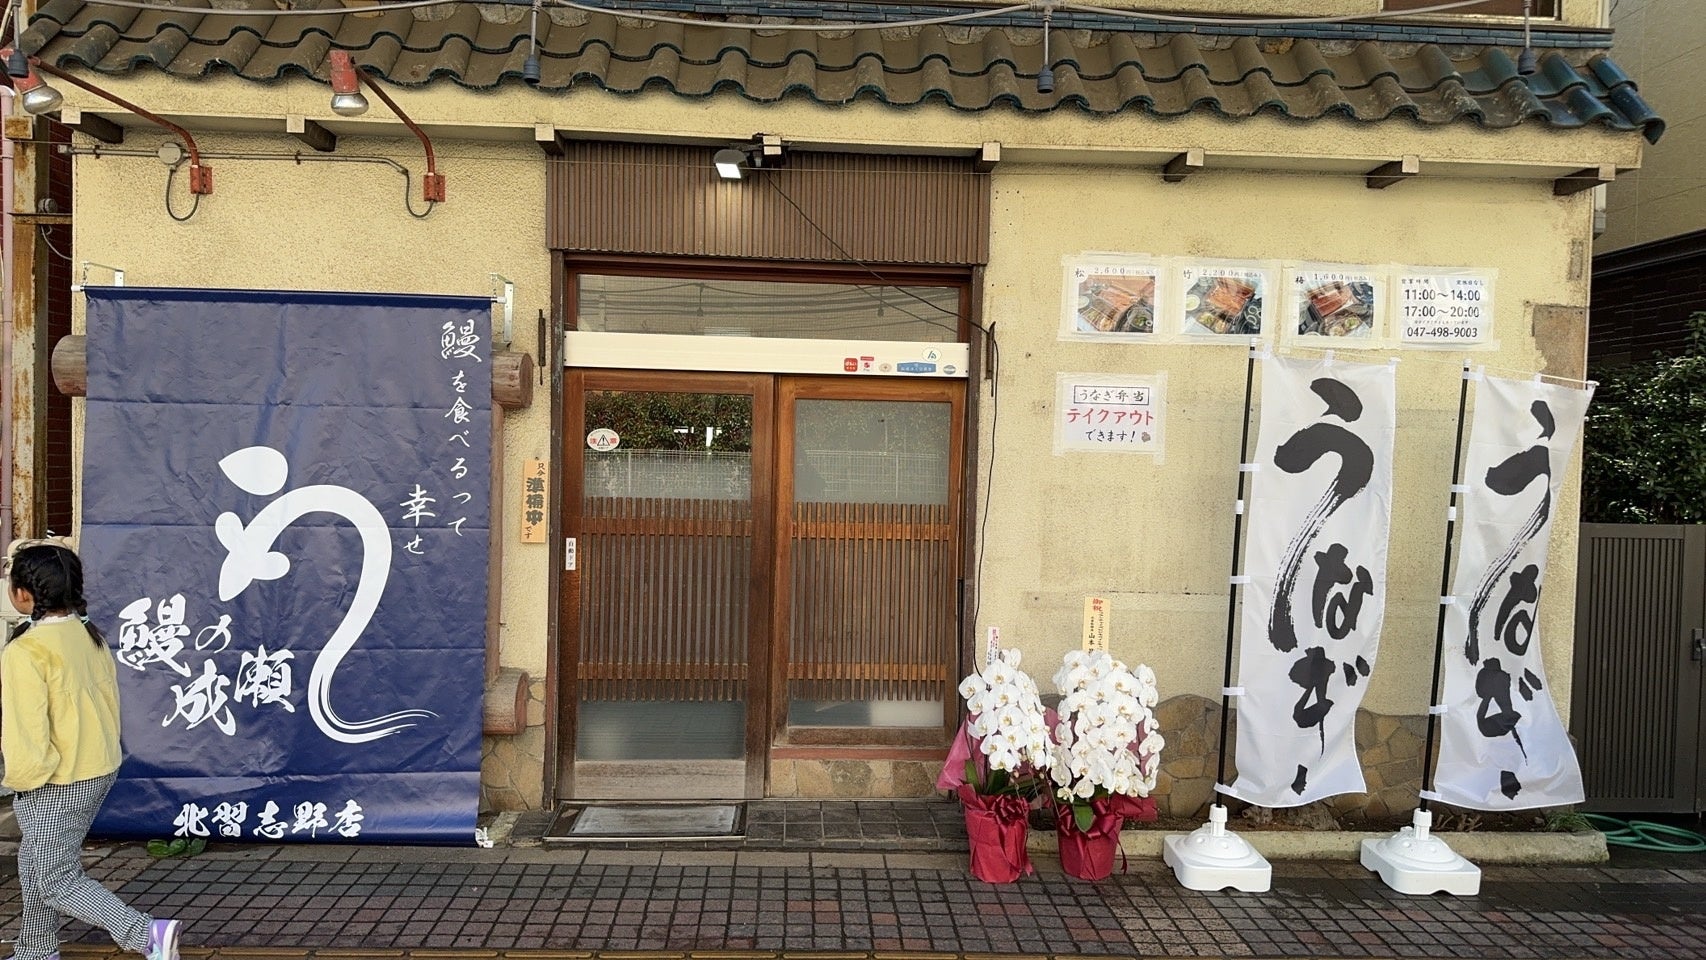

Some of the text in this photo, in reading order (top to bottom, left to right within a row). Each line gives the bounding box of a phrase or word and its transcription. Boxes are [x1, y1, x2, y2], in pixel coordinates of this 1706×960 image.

[1183, 269, 1192, 279] 竹
[1407, 326, 1478, 338] 047-498-9003
[1079, 389, 1145, 402] うなぎ弁当
[441, 319, 482, 536] 鰻を食べるって
[1066, 408, 1154, 426] テイクアウト
[1085, 428, 1136, 443] できます!
[400, 483, 437, 556] 幸せ
[524, 462, 546, 539] 只今 準備中 です
[1267, 377, 1375, 796] うなぎ
[1463, 399, 1557, 801] うなぎ
[173, 800, 365, 840] 北習志野店
